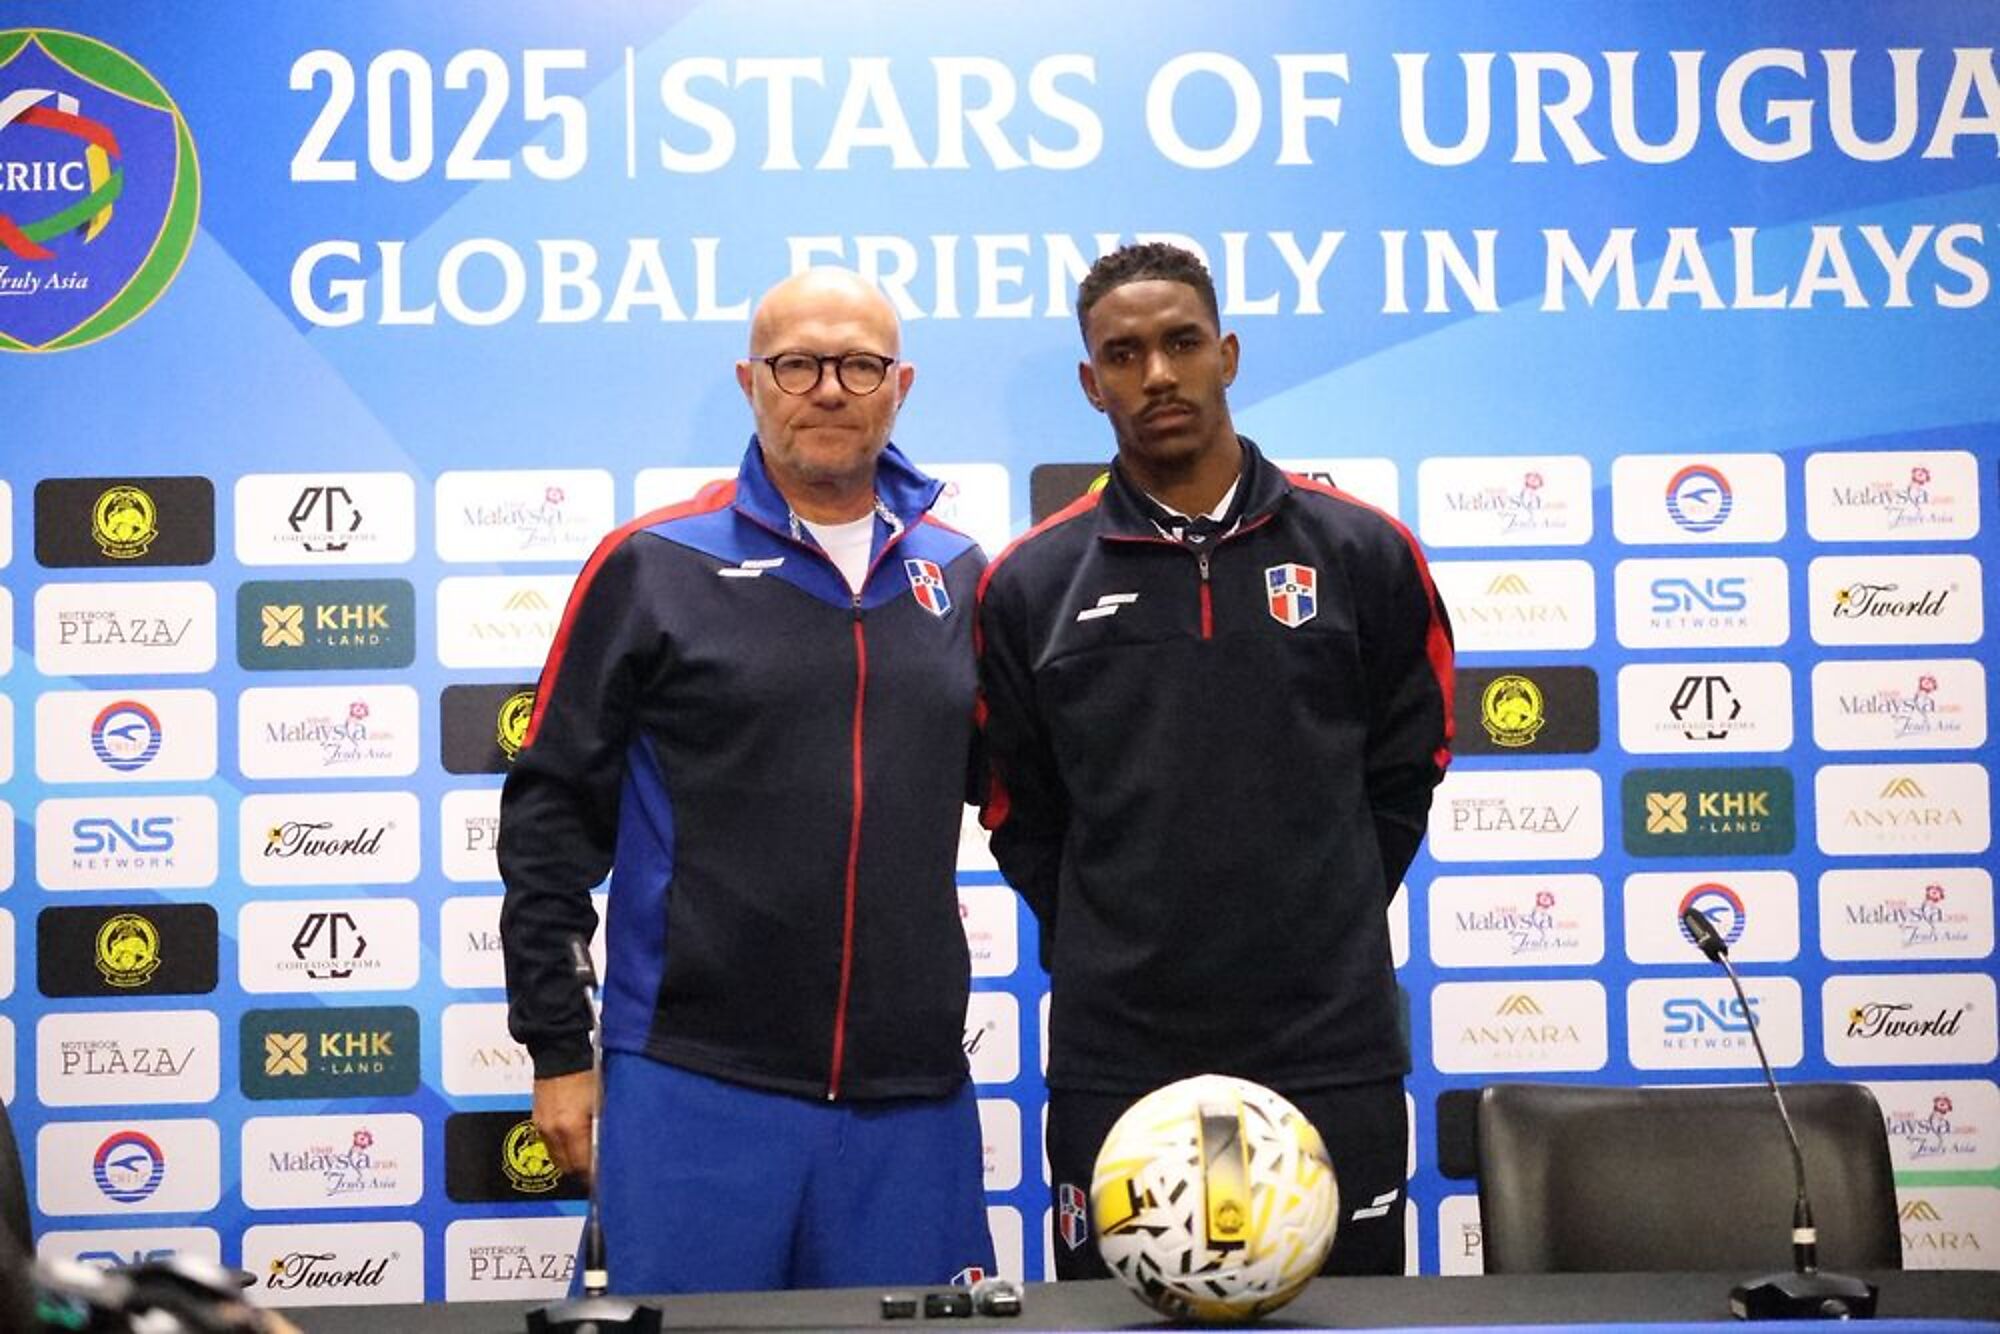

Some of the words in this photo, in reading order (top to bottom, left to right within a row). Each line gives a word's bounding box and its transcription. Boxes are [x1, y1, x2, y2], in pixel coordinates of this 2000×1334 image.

[290, 48, 588, 182] 2025
[659, 54, 1102, 174] STARS
[1146, 51, 1350, 169] OF
[1392, 47, 2000, 167] URUGUA
[0, 160, 86, 192] RIIC
[44, 271, 89, 290] Asia
[290, 236, 750, 329] GLOBAL
[1379, 229, 1501, 314] IN
[1540, 222, 2000, 312] MALAYS
[1651, 578, 1747, 612] SNS
[316, 604, 390, 630] KHK
[1651, 617, 1748, 628] NETWORK
[328, 635, 381, 647] LAND
[1699, 791, 1770, 817] KHK
[1710, 821, 1761, 833] LAND
[1843, 808, 1963, 827] ANYARA
[73, 816, 174, 854] SNS
[73, 857, 175, 870] NETWORK
[1663, 998, 1760, 1032] SNS
[320, 1032, 394, 1057] KHK
[1459, 1025, 1581, 1043] ANYARA
[1664, 1038, 1757, 1049] NETWOR
[331, 1062, 385, 1074] LAND
